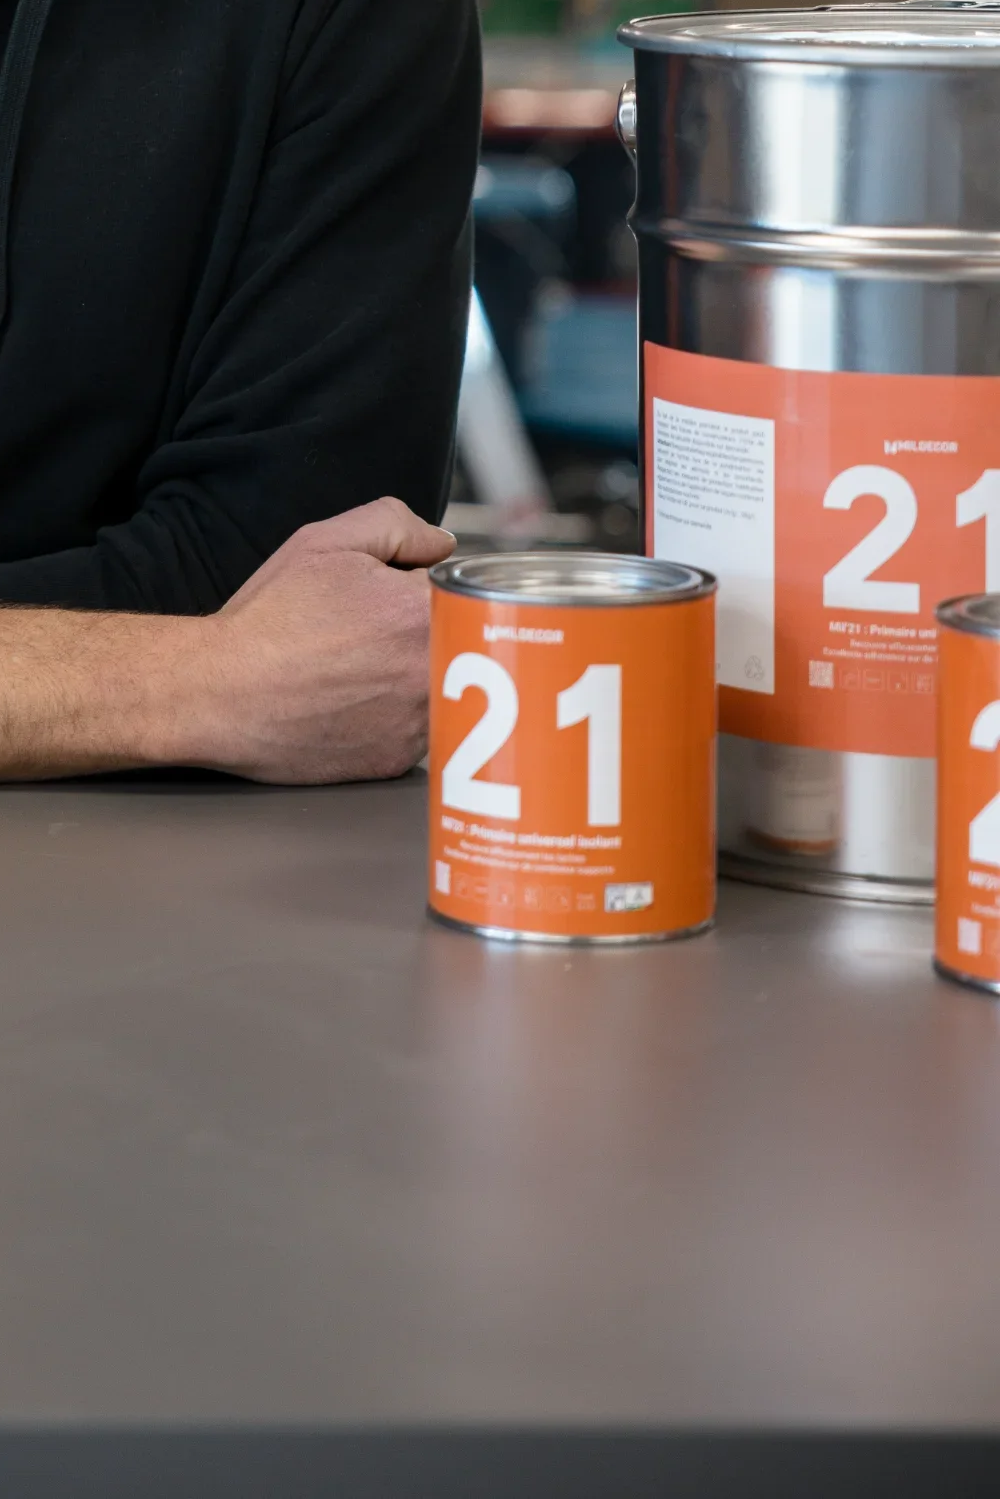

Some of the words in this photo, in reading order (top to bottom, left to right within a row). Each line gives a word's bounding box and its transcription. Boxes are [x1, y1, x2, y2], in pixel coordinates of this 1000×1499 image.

[897, 439, 958, 454] MILDECOR
[496, 626, 564, 645] MILDECOR
[442, 652, 622, 827] 21
